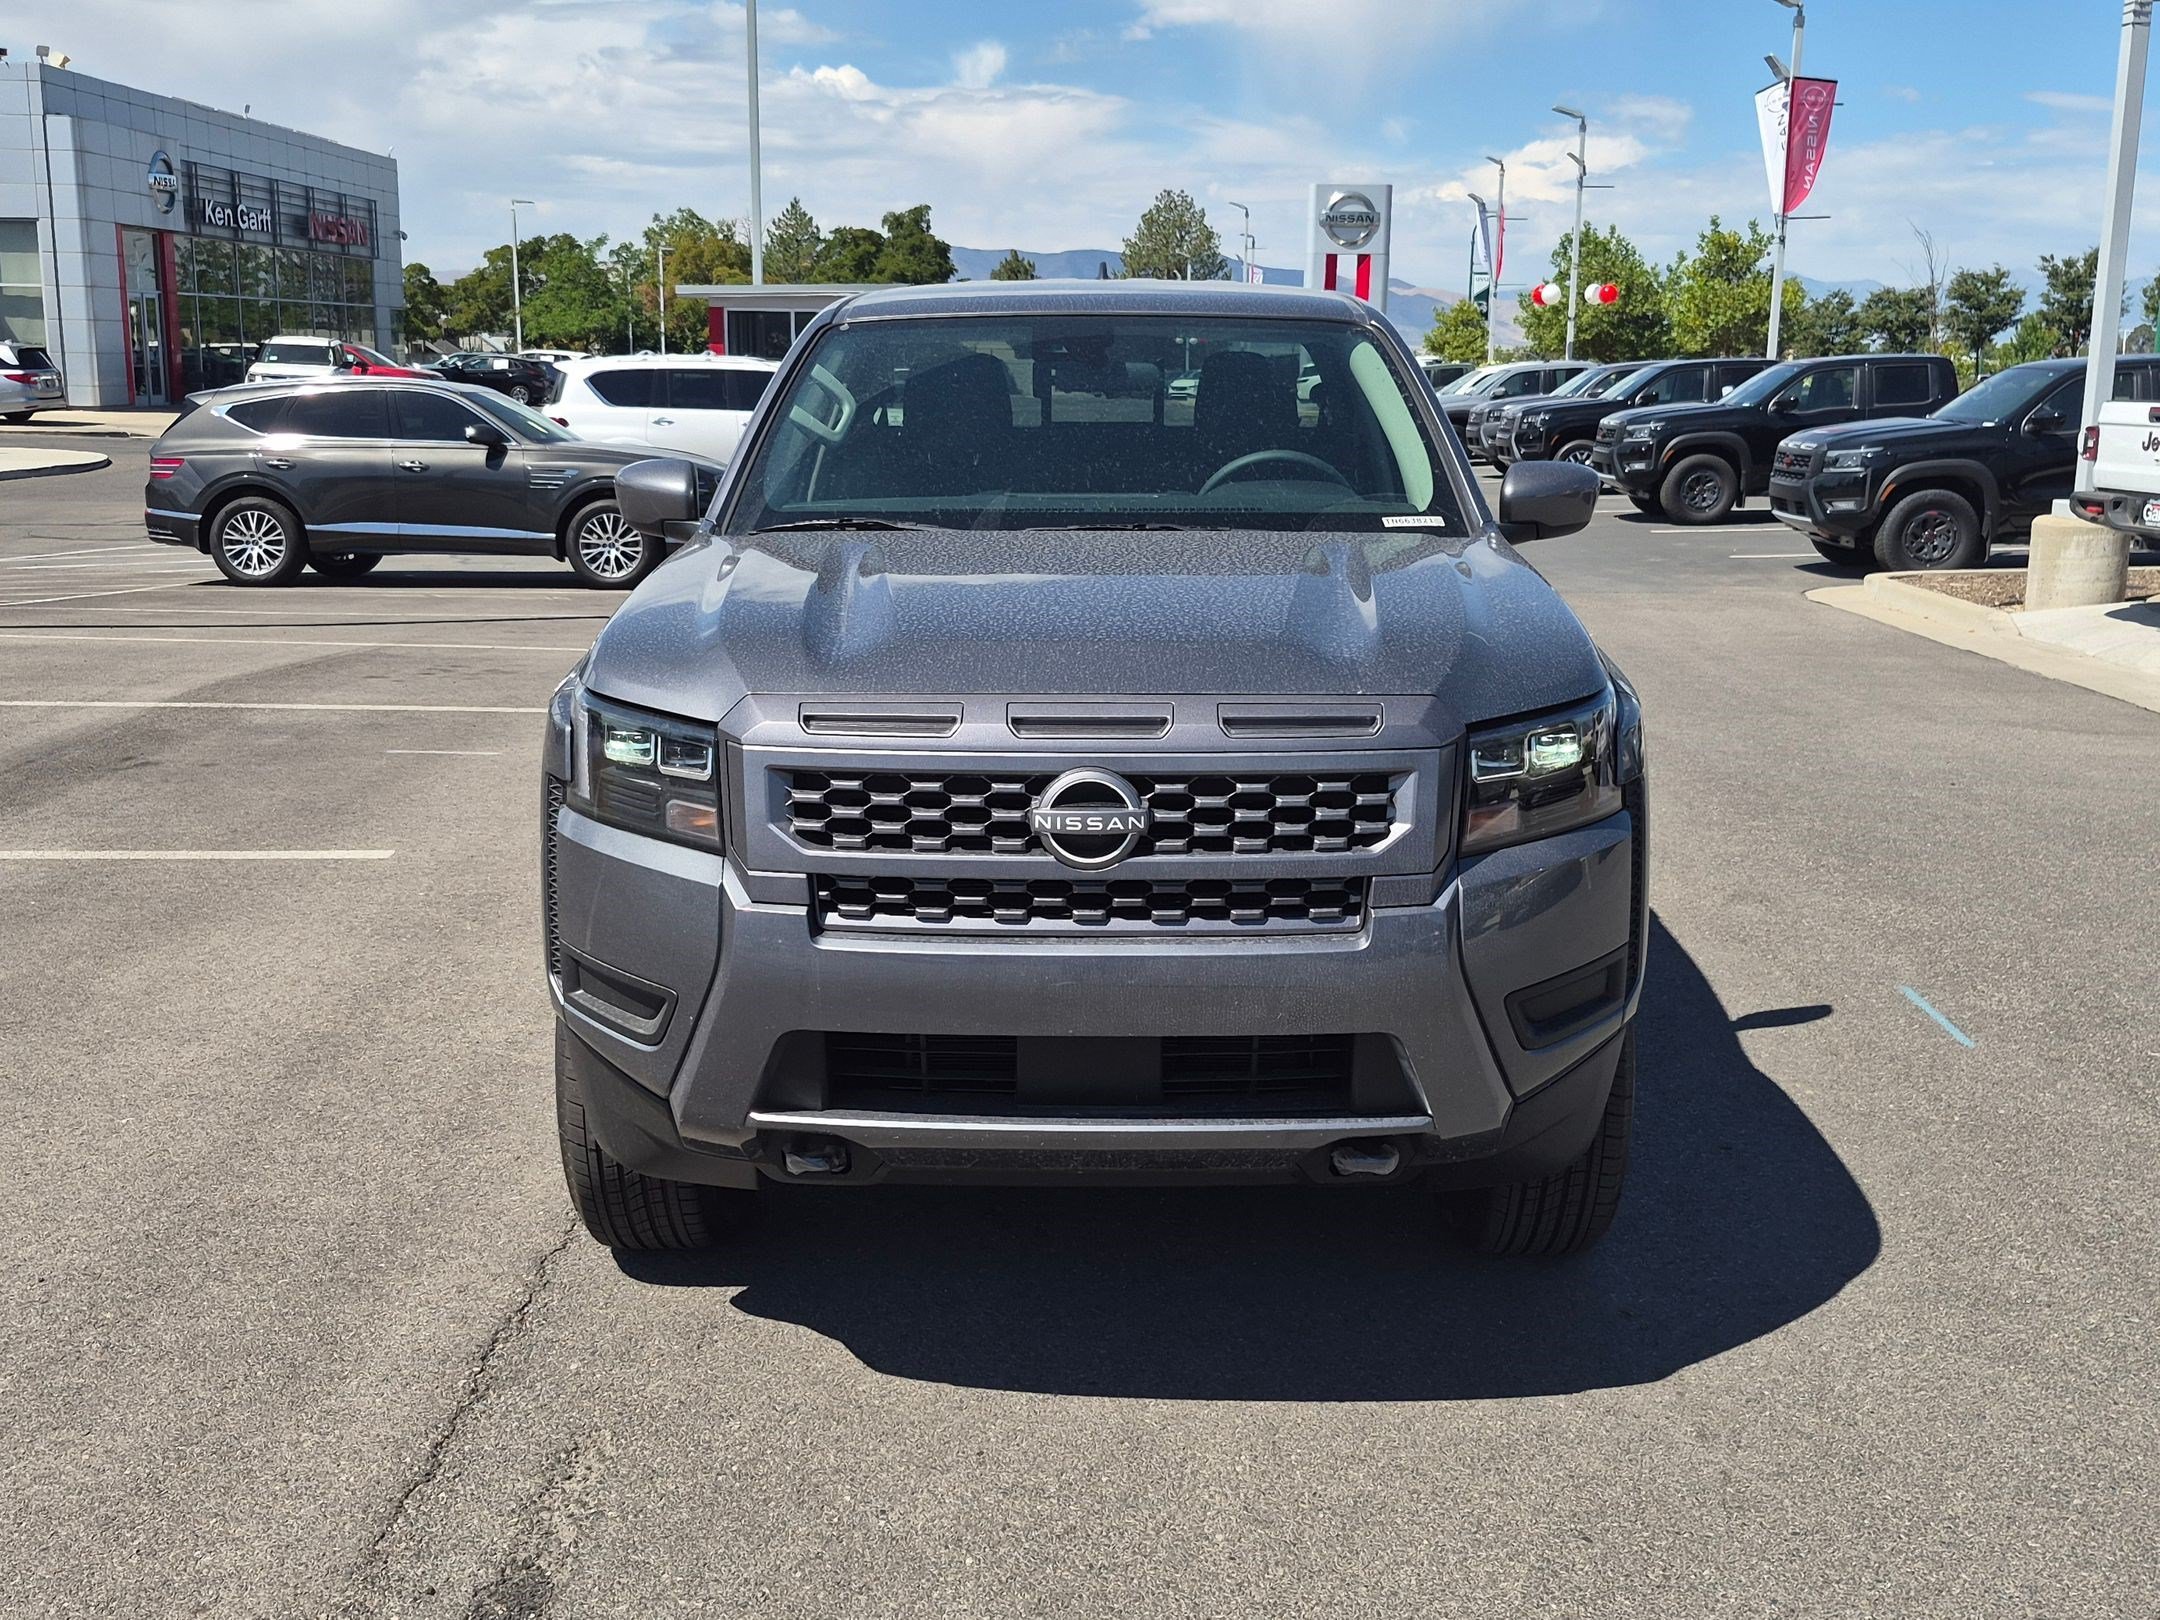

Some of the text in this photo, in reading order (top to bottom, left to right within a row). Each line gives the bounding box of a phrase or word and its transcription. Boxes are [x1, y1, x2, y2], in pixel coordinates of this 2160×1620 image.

[205, 198, 272, 233] Ken Garff
[1325, 214, 1375, 224] NISSAN
[2142, 431, 2160, 453] Je
[1034, 814, 1145, 831] NISSAN
